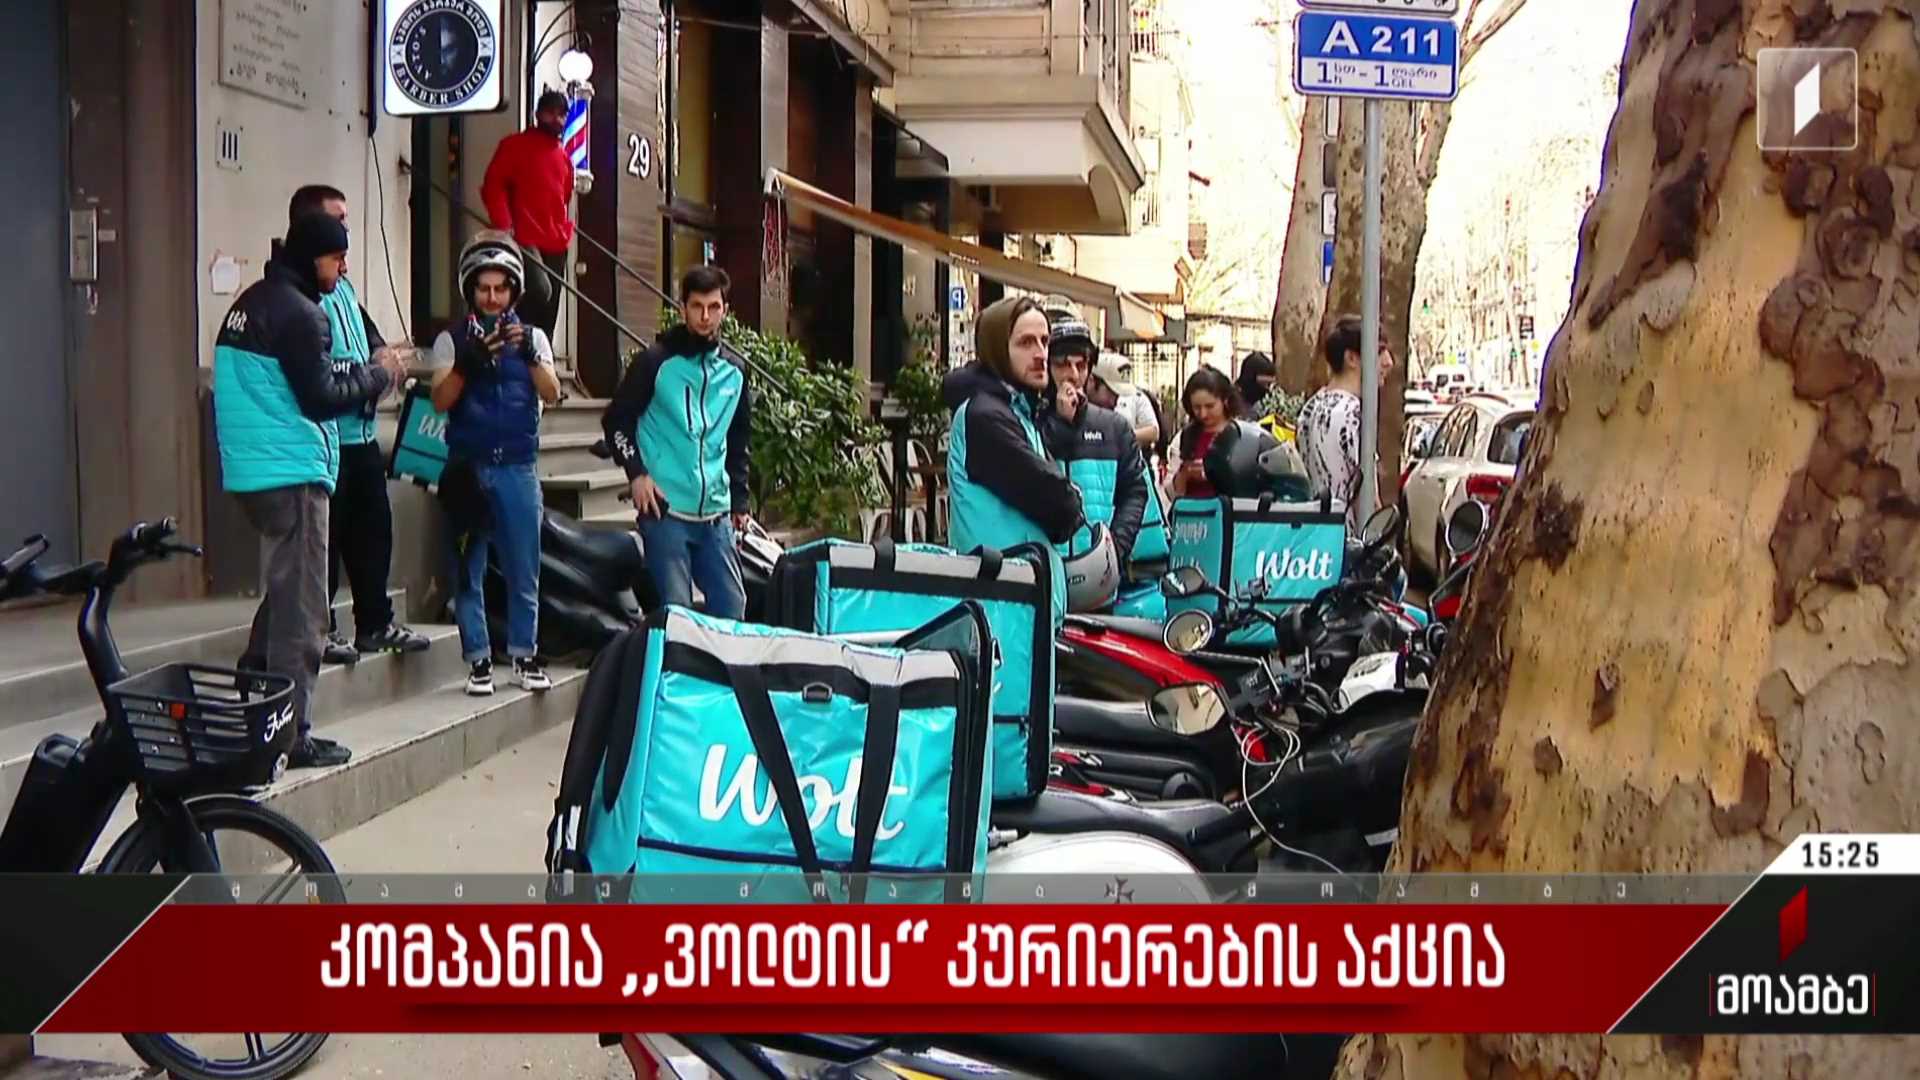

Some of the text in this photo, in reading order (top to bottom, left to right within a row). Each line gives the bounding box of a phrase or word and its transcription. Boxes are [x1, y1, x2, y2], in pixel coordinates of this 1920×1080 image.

[1320, 20, 1440, 57] A 211
[396, 60, 487, 105] BARBER SHOP
[1317, 61, 1332, 84] 1
[1374, 64, 1389, 87] 1
[628, 133, 651, 178] 29
[330, 360, 352, 376] olt
[1255, 549, 1334, 581] Wolt
